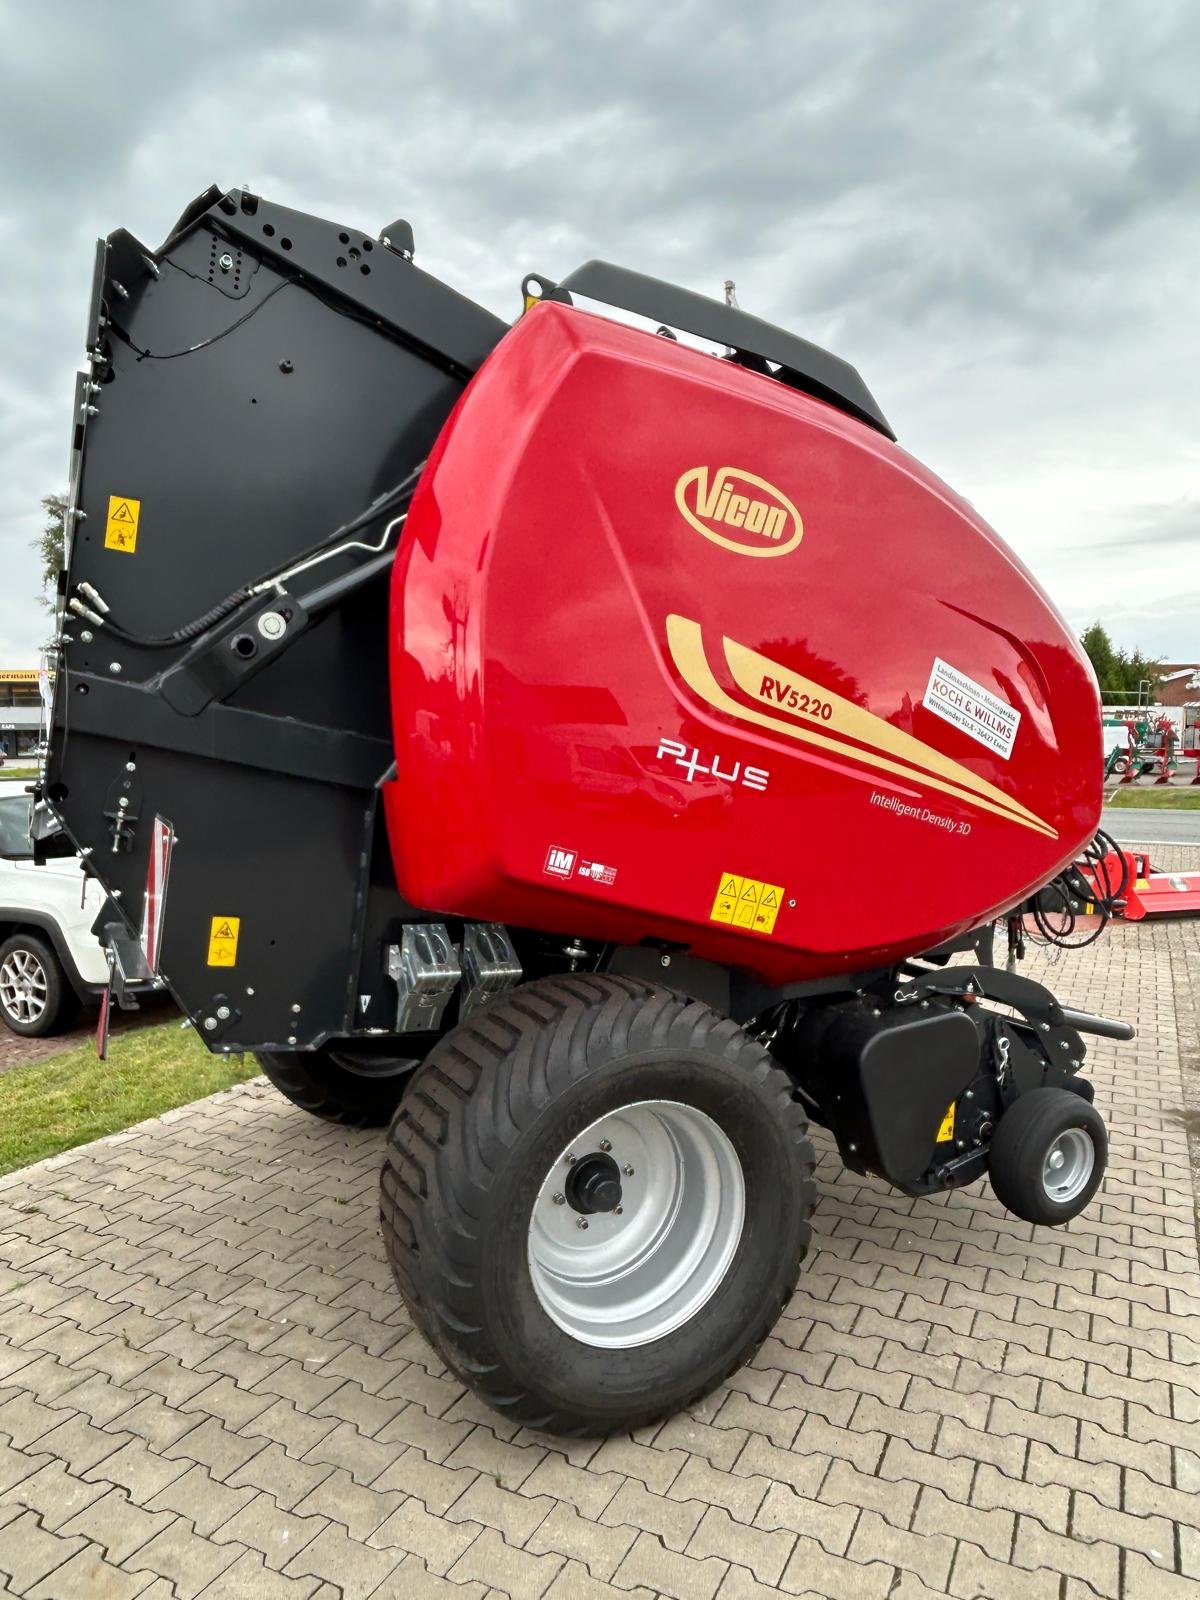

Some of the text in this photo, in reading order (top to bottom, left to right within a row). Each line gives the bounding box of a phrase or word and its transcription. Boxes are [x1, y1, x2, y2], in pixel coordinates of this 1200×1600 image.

[695, 466, 788, 540] Vicon
[759, 675, 833, 721] RV5220
[932, 678, 1012, 740] KOCH & WILLMS
[656, 738, 770, 791] PLUS
[870, 791, 972, 835] Intelligent Density 3D
[548, 849, 575, 871] iM
